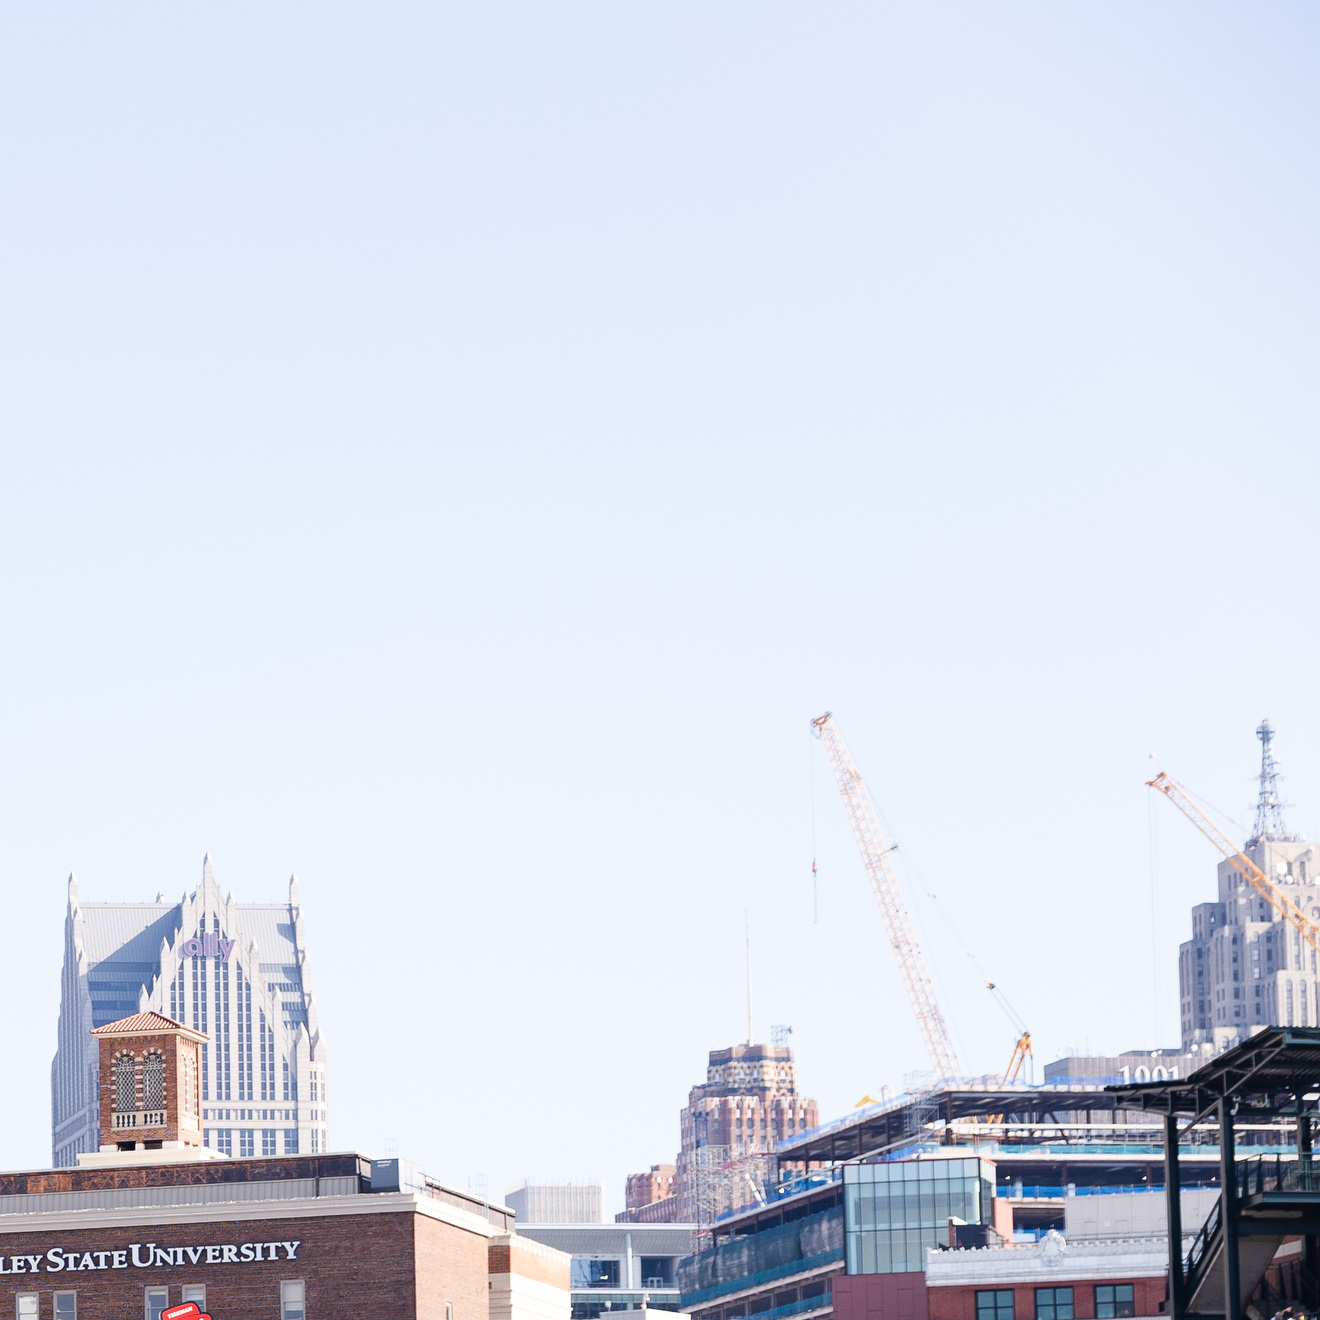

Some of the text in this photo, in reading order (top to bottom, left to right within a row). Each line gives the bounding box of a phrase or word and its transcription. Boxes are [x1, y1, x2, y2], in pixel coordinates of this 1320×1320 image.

[183, 931, 236, 963] ally
[1118, 1064, 1179, 1085] 1001
[47, 1247, 128, 1272] STATE
[129, 1241, 301, 1267] UNIVERSITY
